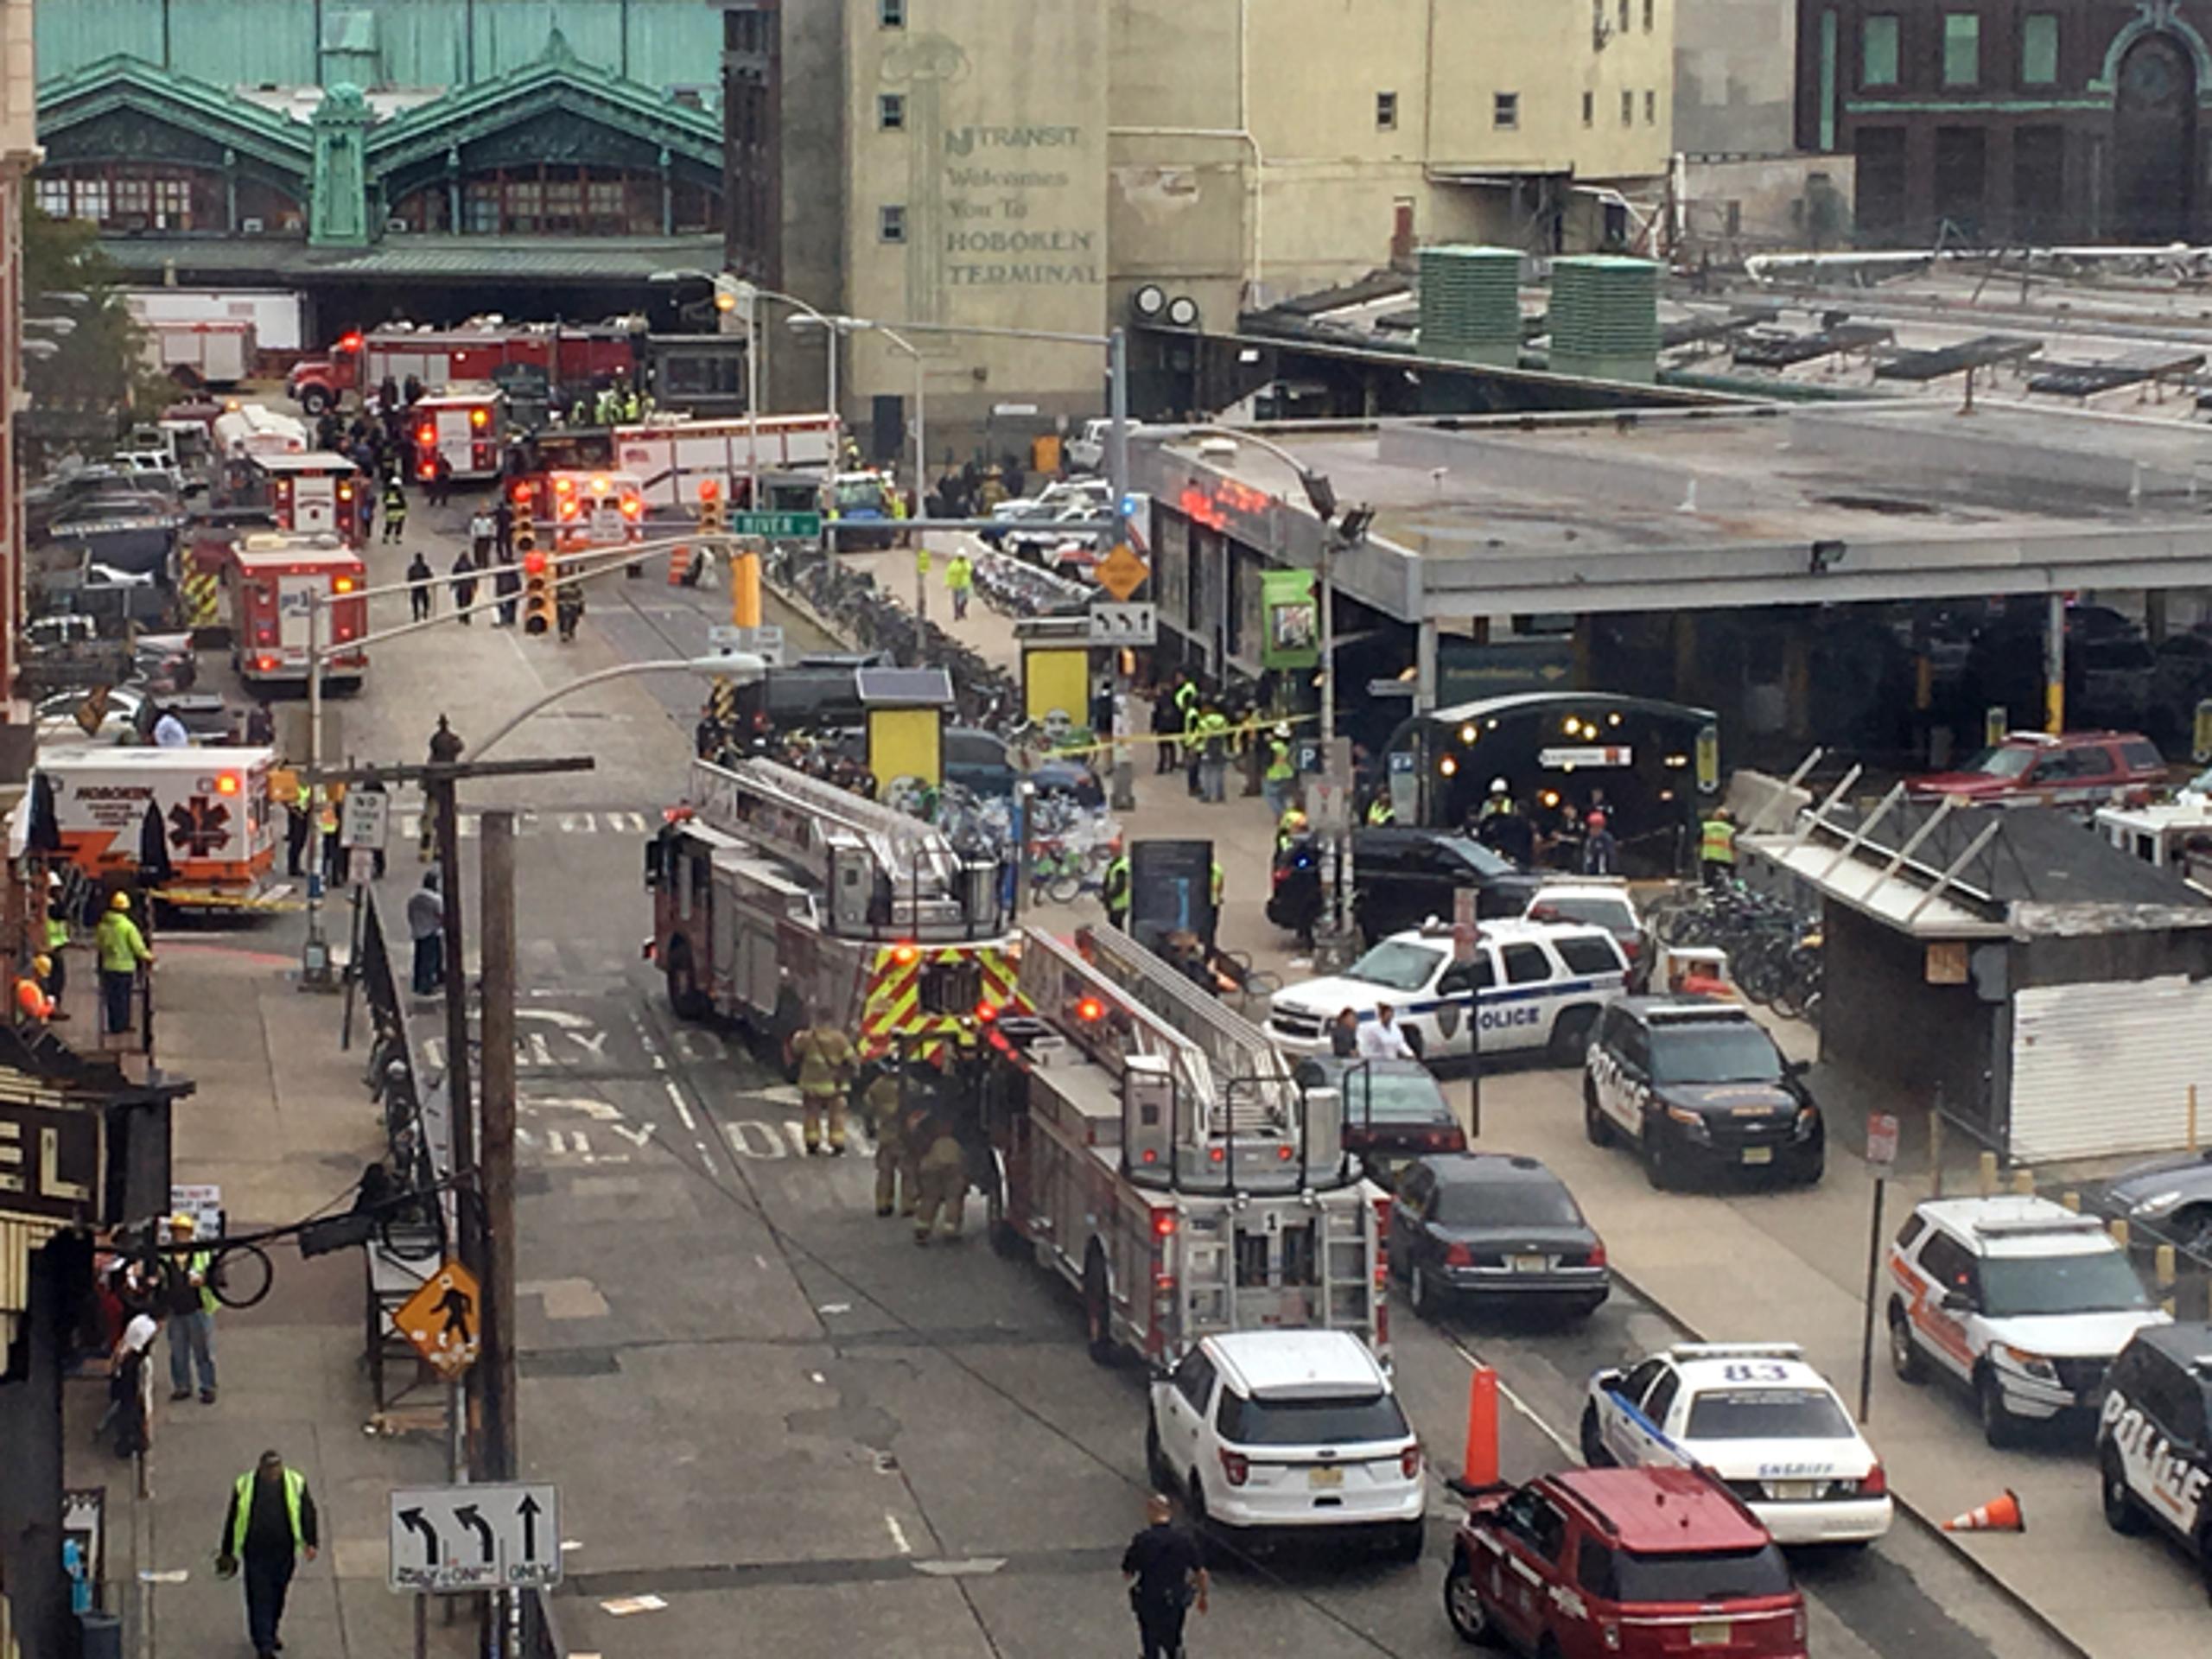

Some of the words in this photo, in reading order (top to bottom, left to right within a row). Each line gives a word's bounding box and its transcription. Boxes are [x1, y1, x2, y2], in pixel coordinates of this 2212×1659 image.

[946, 168, 1070, 188] Welcomes
[946, 199, 992, 219] You
[997, 197, 1027, 219] To
[947, 229, 1096, 253] HOBOKEN
[948, 263, 1103, 286] TERMINAL
[1300, 748, 1316, 769] P
[354, 796, 378, 808] NO
[1267, 1213, 1278, 1232] 1
[2094, 1388, 2211, 1512] POLICE
